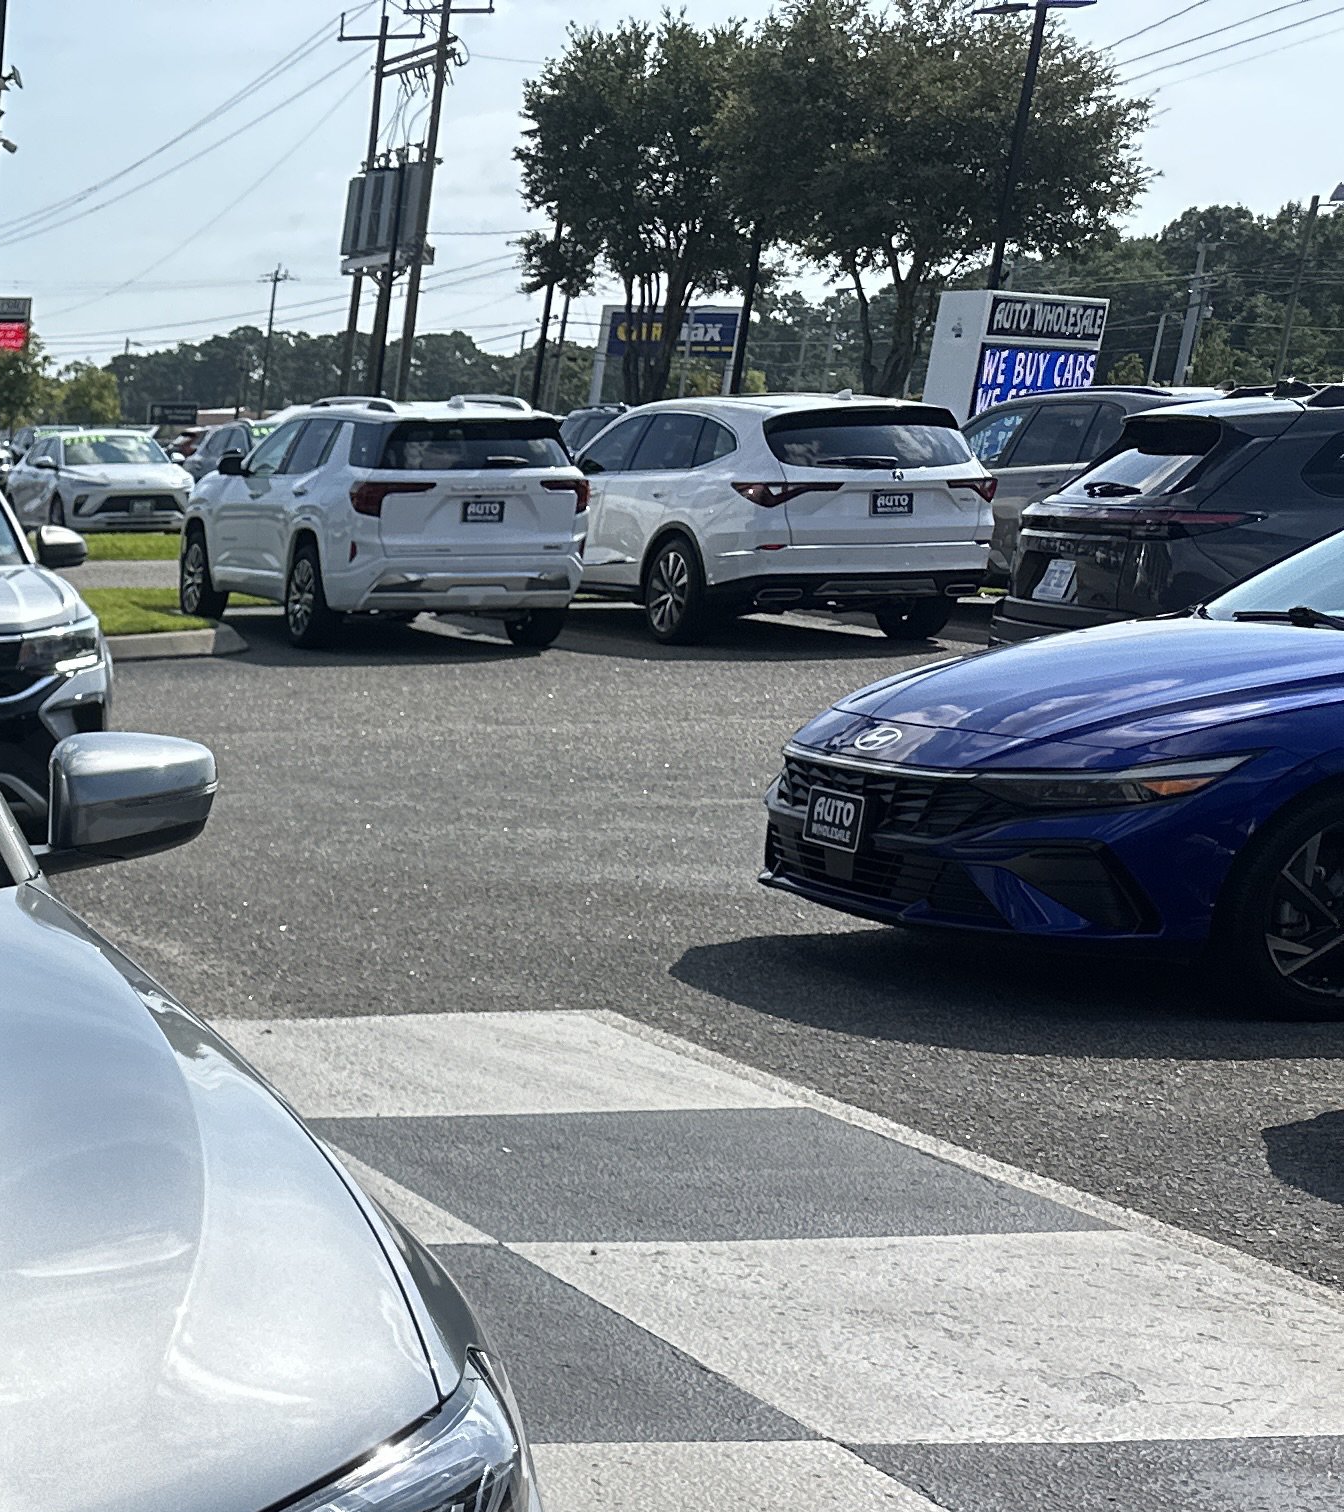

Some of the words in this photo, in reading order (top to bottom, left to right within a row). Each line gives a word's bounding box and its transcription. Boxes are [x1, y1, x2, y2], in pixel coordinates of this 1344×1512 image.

[993, 302, 1031, 330] AUTO
[1033, 304, 1104, 337] WHOLESALE
[981, 349, 1009, 385] WE
[1012, 352, 1050, 387] BUY
[1053, 354, 1096, 387] CARS
[467, 503, 500, 514] AUTO
[876, 495, 909, 507] AUTO
[813, 796, 855, 827] AUTO
